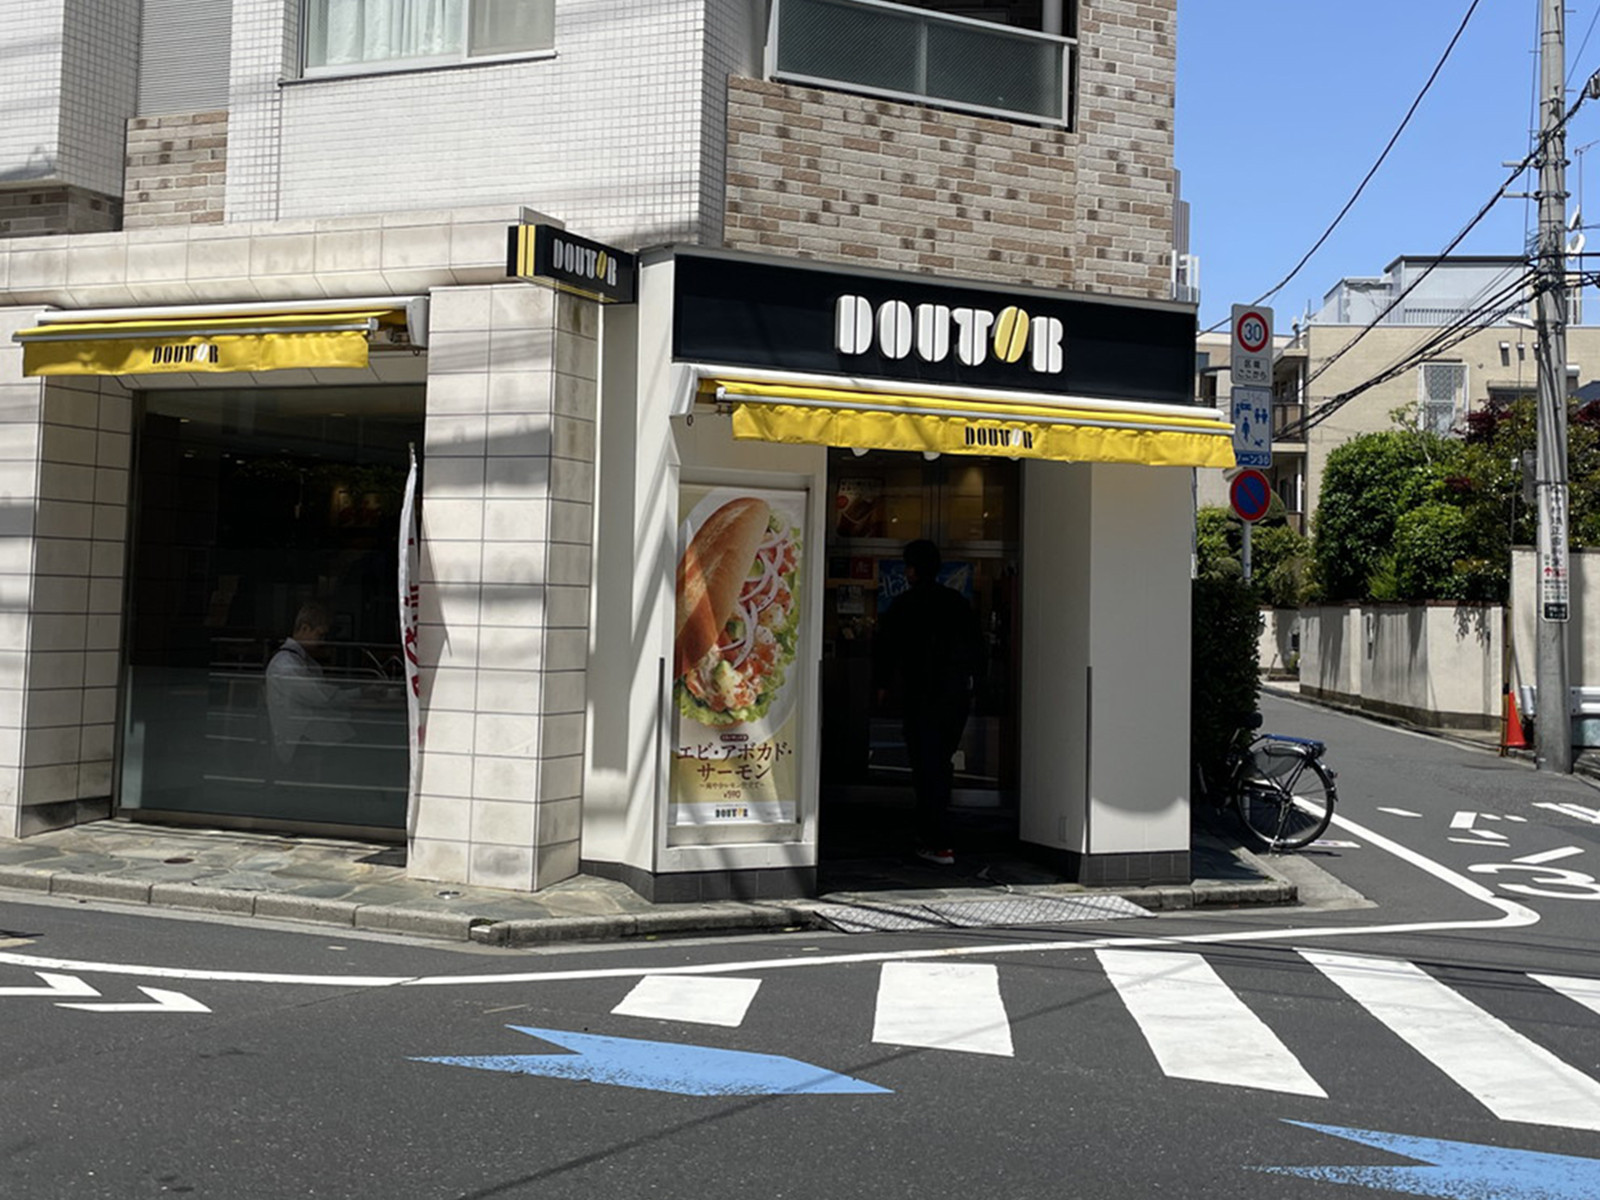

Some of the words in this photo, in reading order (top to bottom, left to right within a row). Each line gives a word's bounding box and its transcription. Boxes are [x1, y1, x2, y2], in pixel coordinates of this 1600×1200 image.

[553, 239, 617, 286] DOUTOR
[836, 294, 1064, 374] DOUTOR
[1244, 323, 1262, 341] 30
[152, 343, 219, 364] DOUTOR
[965, 426, 1033, 449] DOUTOR
[696, 763, 771, 781] サーモン
